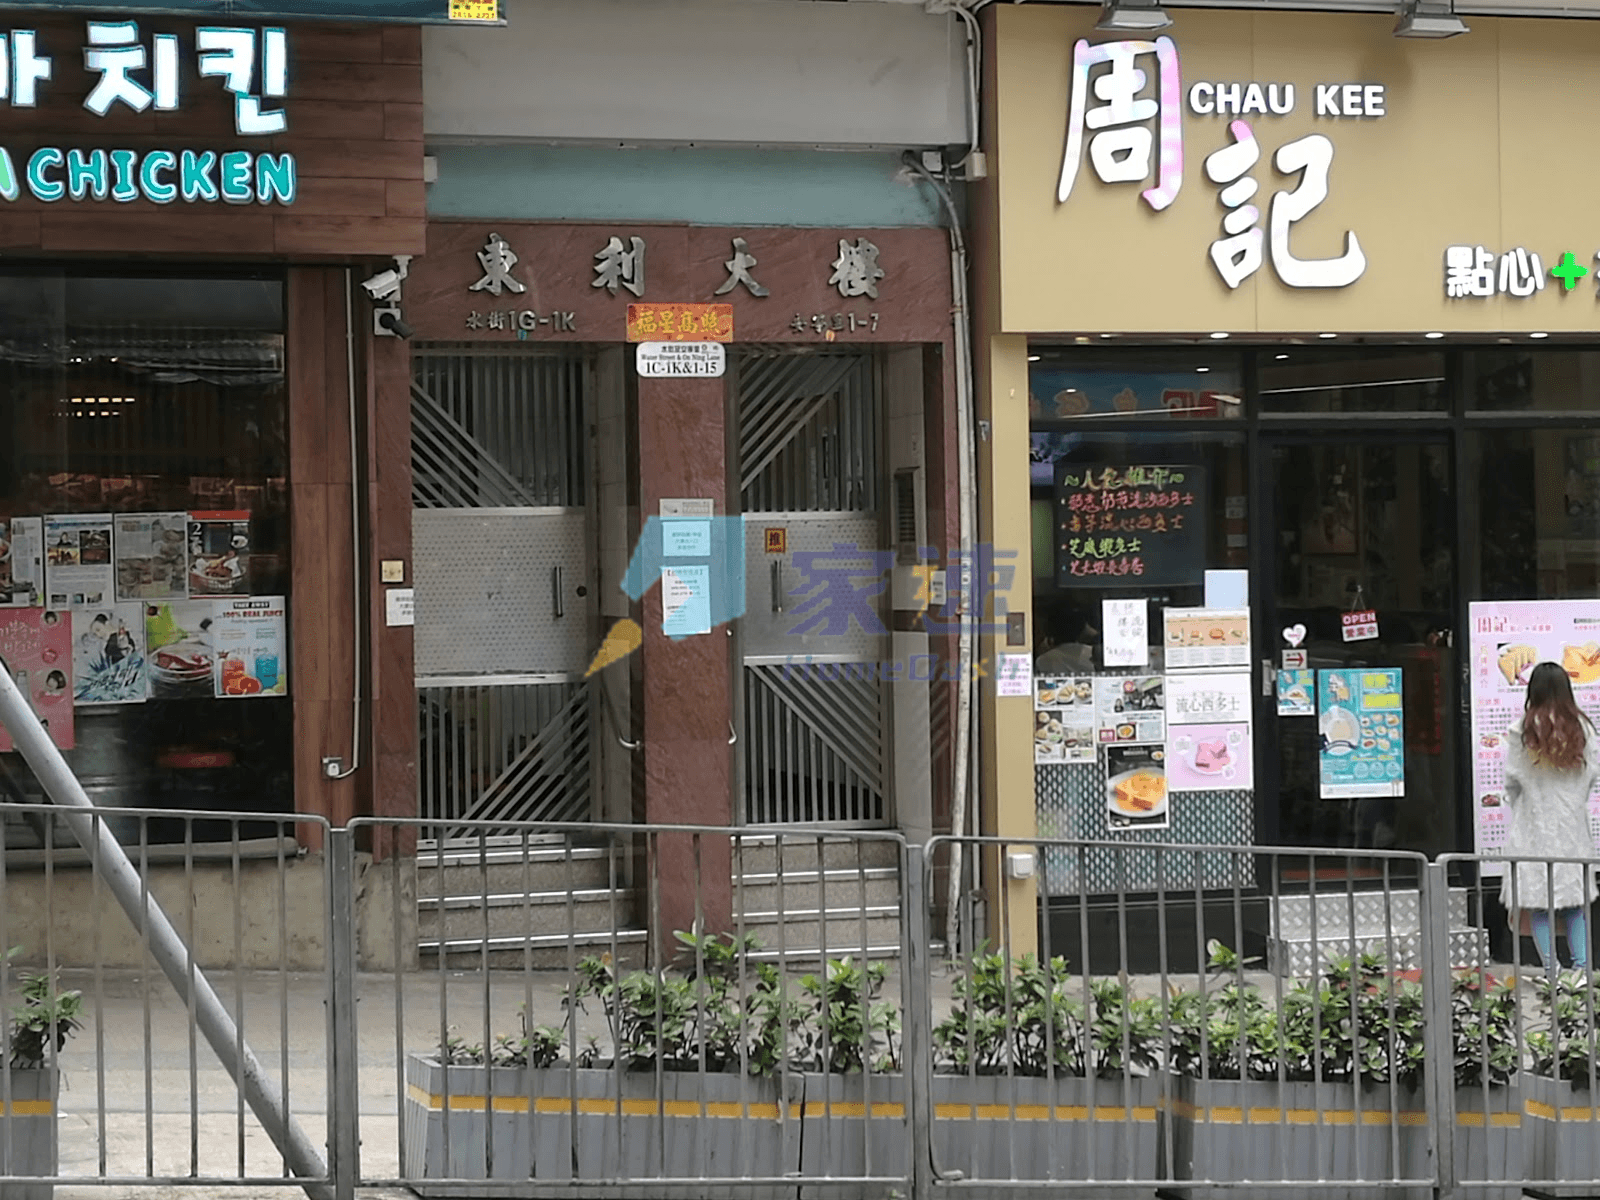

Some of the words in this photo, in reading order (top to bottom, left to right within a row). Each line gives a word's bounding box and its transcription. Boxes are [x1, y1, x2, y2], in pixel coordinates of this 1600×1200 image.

[81, 20, 287, 136] 치킨
[1190, 82, 1295, 115] CHAU
[1315, 83, 1386, 117] KEE
[26, 146, 297, 206] CHICKEN
[1057, 35, 1367, 290] 周記
[468, 232, 886, 299] 東利大樓
[635, 310, 720, 334] 福星高照
[692, 354, 706, 362] Ning
[1342, 612, 1376, 625] OPEN
